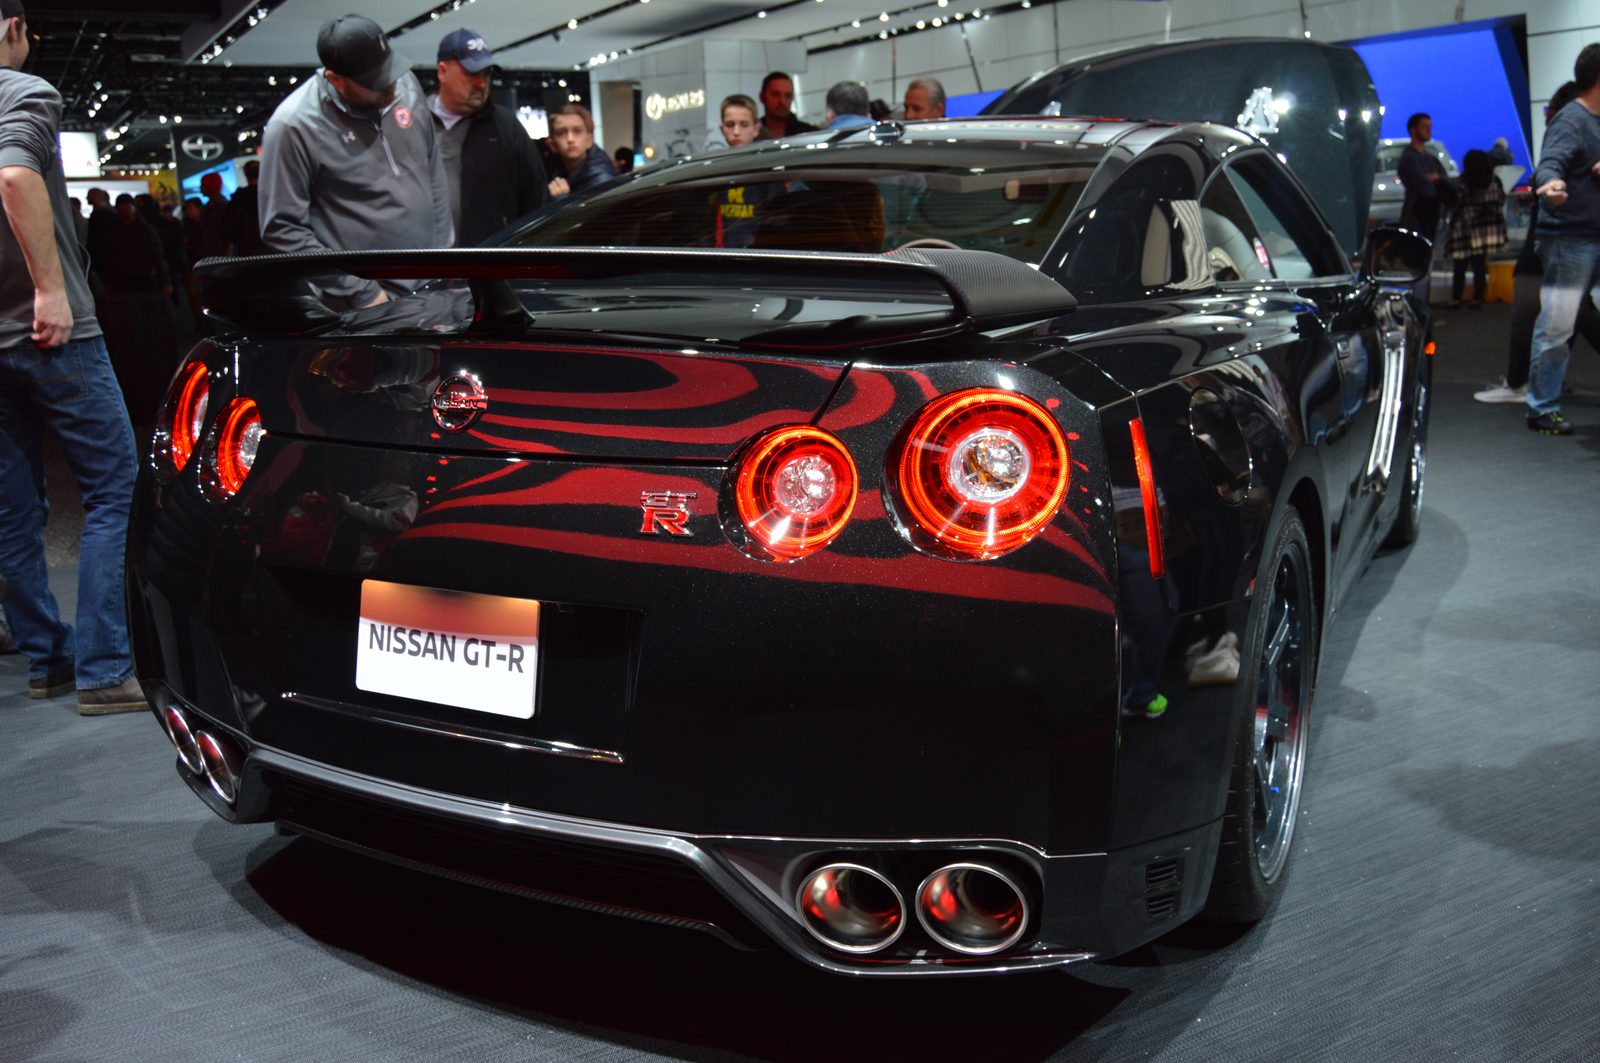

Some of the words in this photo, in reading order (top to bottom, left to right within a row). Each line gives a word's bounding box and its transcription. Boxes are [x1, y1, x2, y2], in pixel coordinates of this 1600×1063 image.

[641, 506, 694, 536] R
[369, 623, 456, 662] NISSAN
[463, 637, 525, 673] GT-R
